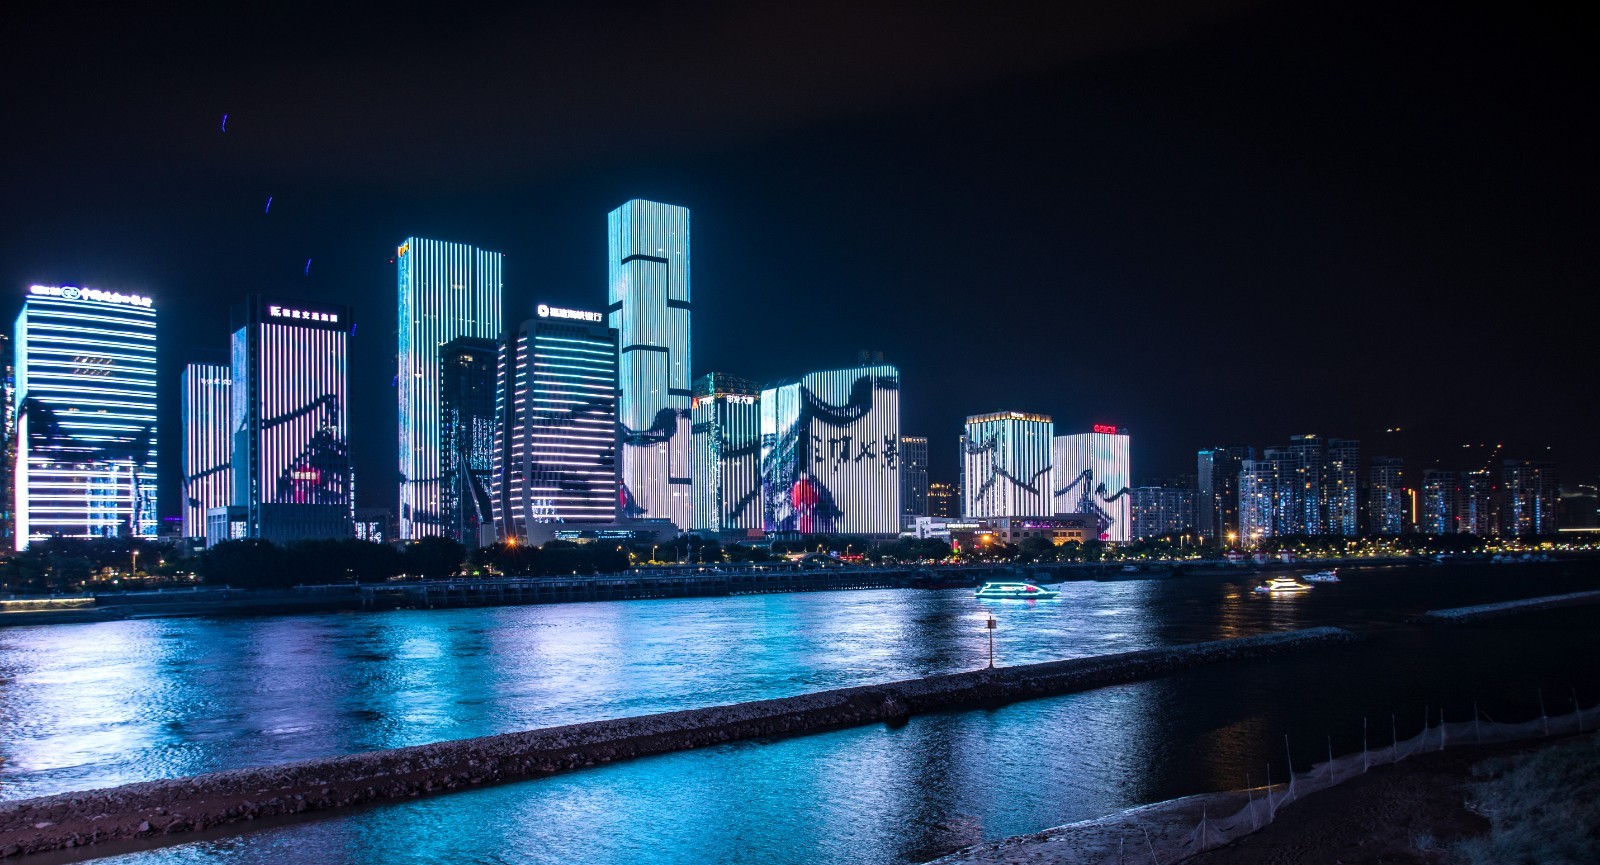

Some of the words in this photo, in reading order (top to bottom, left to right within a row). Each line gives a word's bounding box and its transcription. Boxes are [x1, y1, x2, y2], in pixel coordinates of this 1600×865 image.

[283, 309, 338, 322] 福建交通集团
